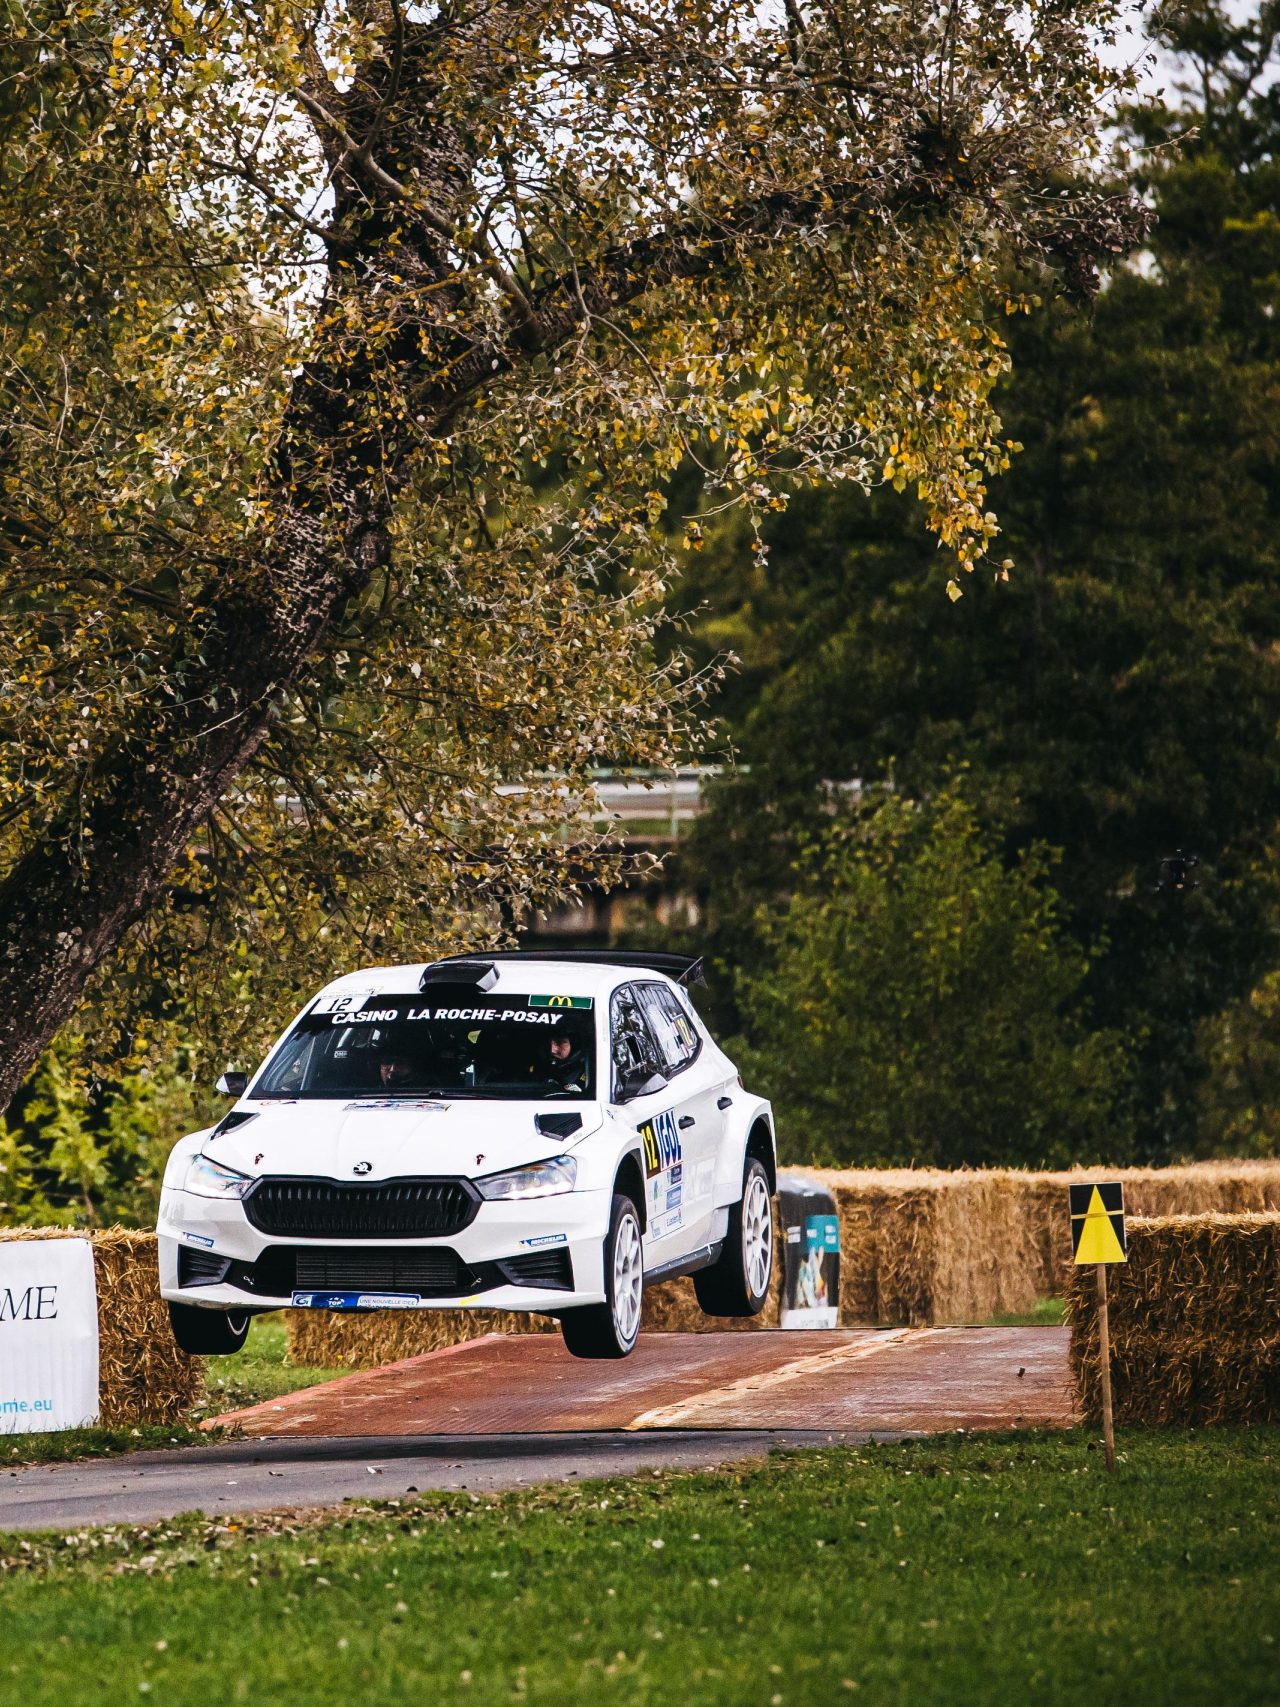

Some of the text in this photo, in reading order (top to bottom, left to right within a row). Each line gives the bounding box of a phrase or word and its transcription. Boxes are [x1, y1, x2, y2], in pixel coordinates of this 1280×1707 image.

[326, 997, 353, 1012] 12
[331, 1008, 563, 1025] CASINO LA ROCHE-POSAY
[676, 1017, 694, 1047] 12
[640, 1110, 682, 1170] 12 IGOL
